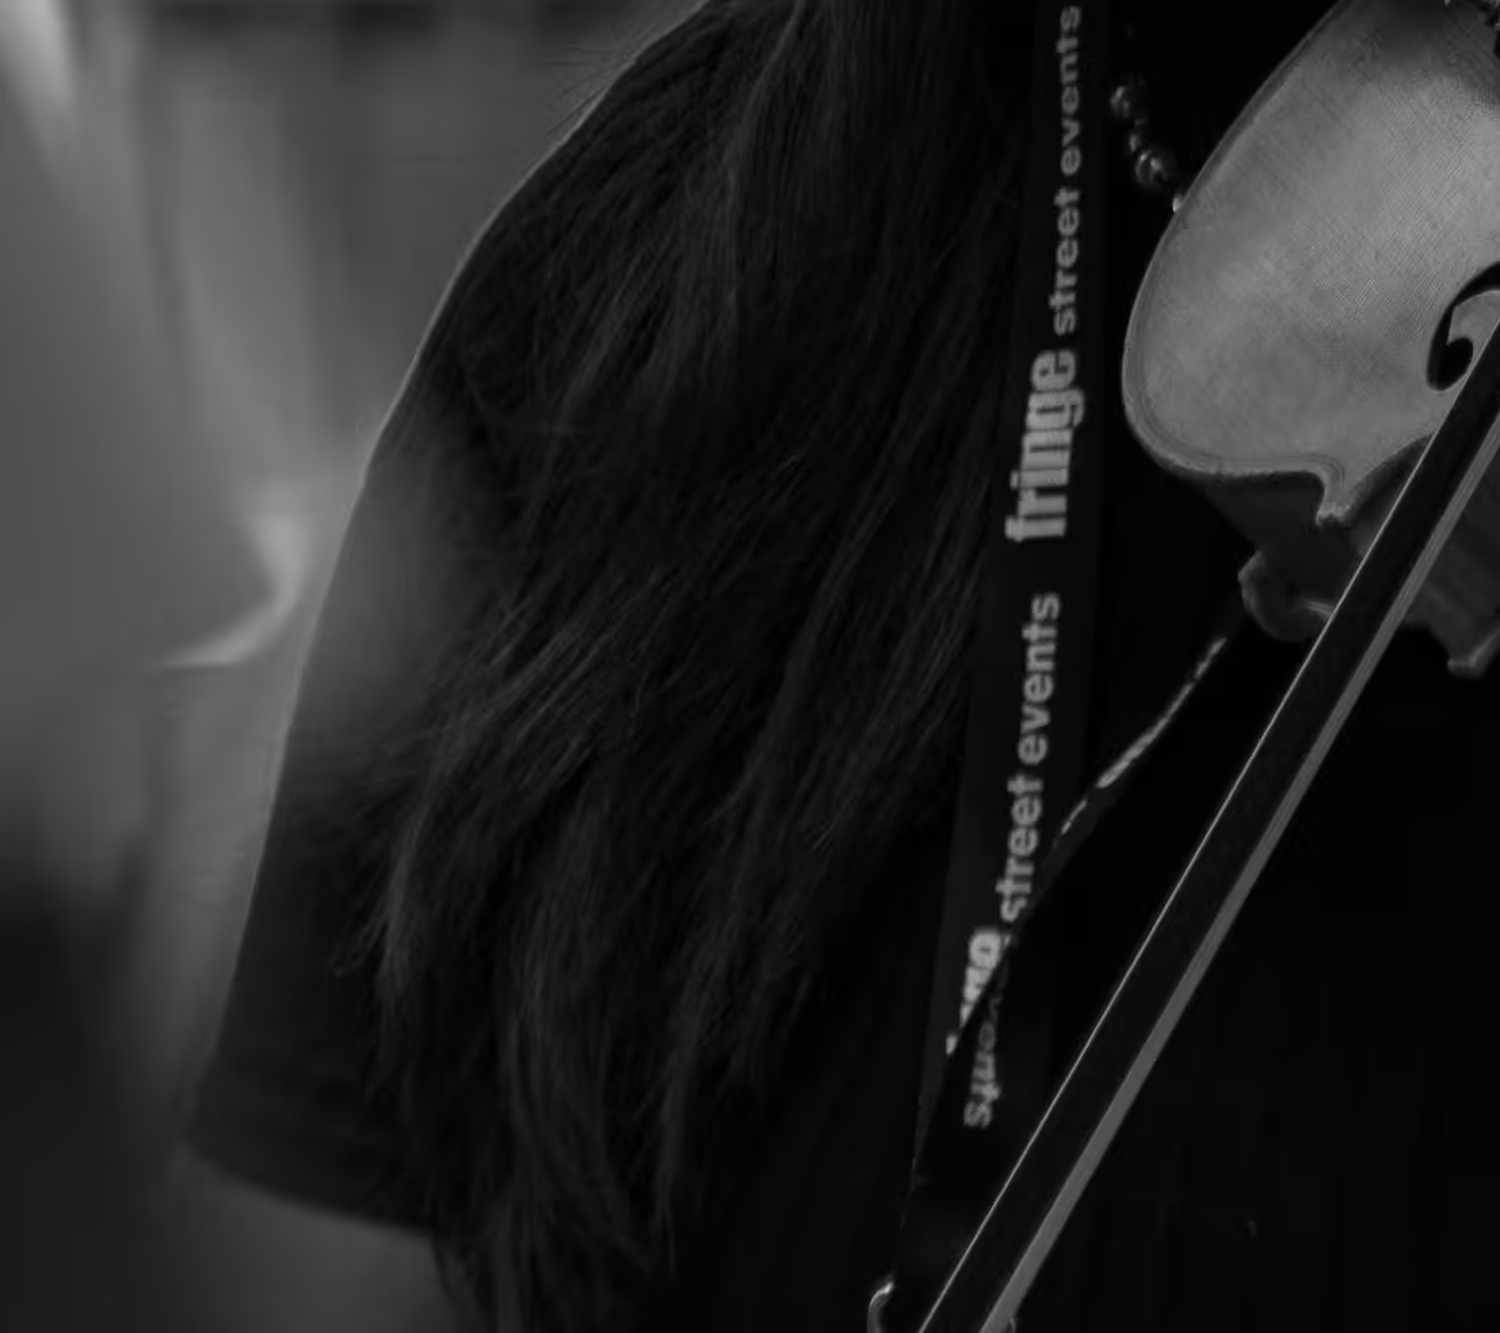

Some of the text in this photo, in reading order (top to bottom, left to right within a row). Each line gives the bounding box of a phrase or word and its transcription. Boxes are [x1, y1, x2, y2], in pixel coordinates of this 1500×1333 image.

[1004, 5, 1085, 543] fringe street events
[994, 591, 1062, 923] street events
